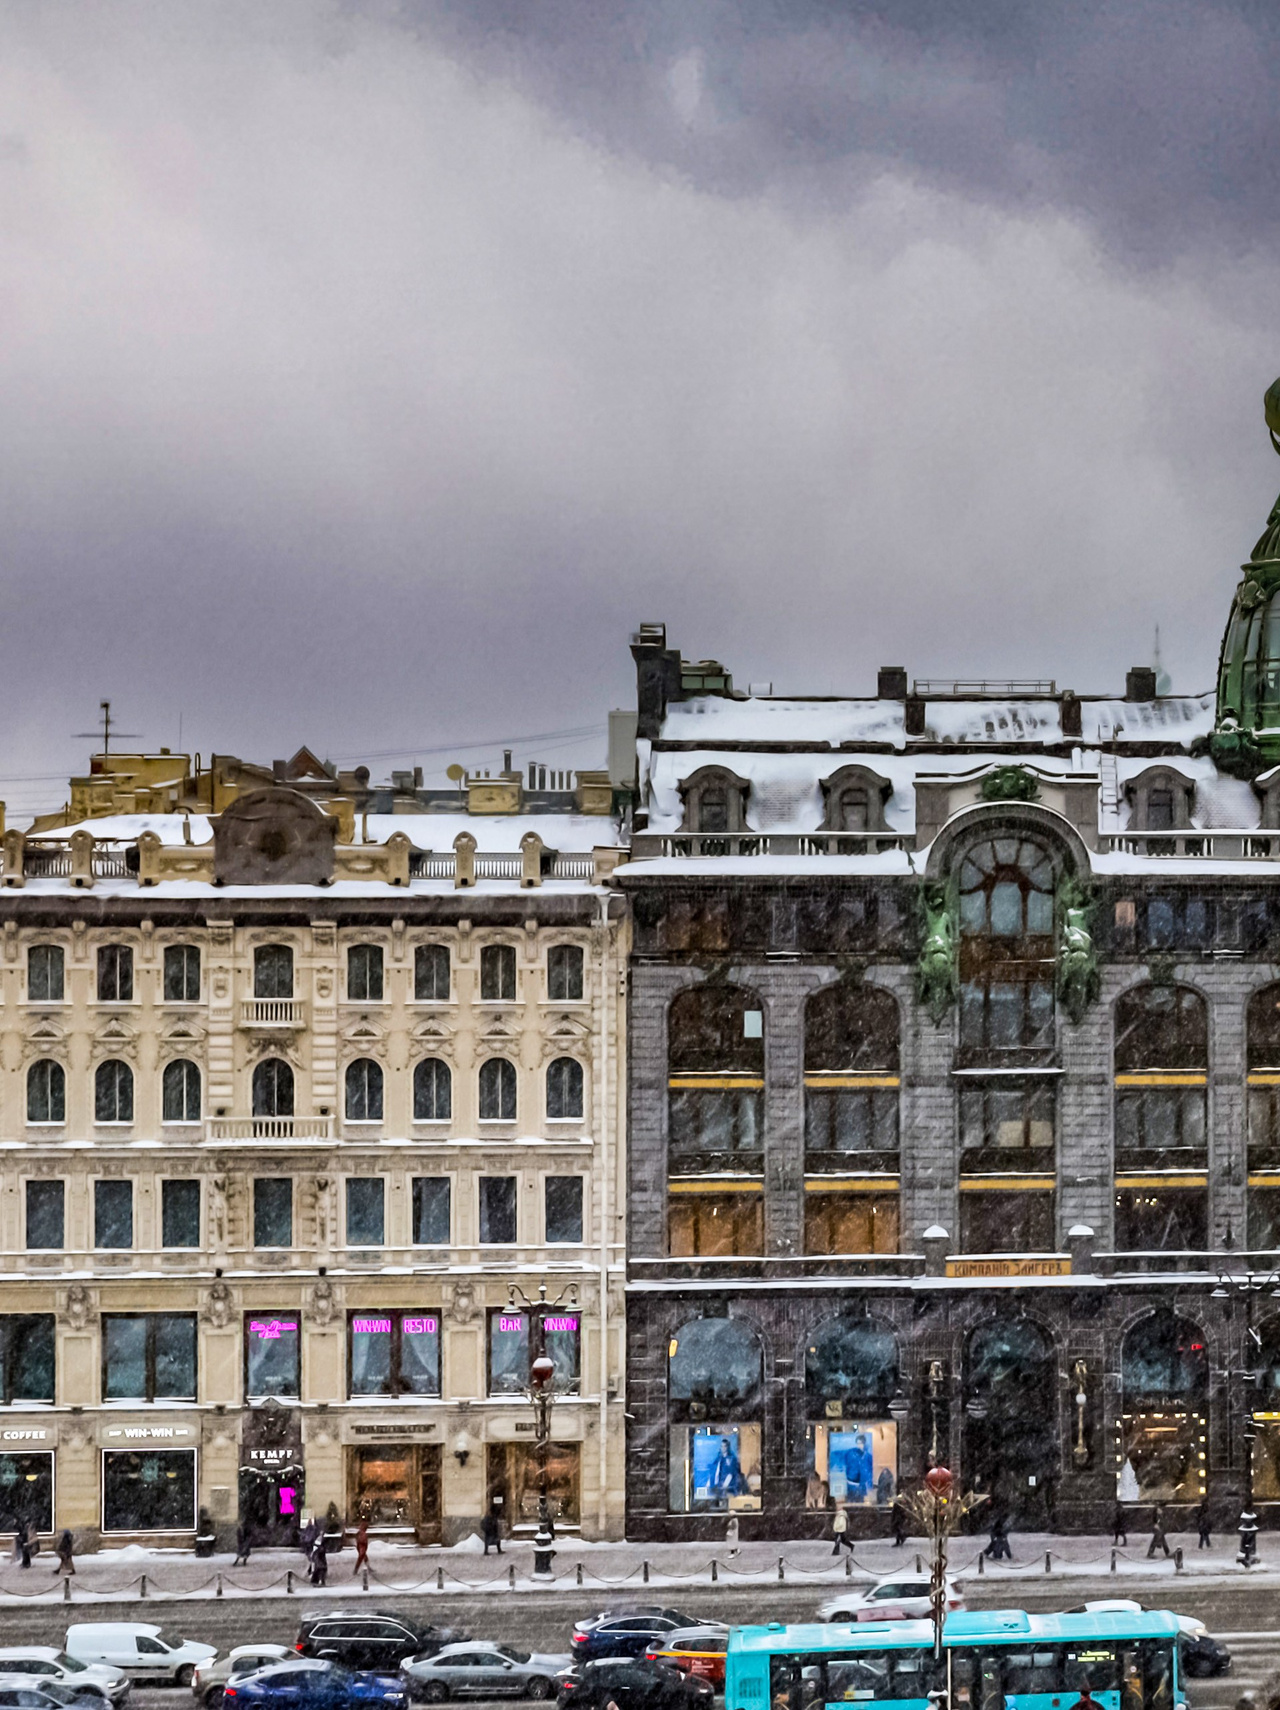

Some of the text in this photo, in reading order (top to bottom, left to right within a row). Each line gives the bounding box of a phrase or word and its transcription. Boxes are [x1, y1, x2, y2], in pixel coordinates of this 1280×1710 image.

[403, 1318, 436, 1334] RESTO
[3, 1430, 46, 1440] COFFEE
[124, 1428, 173, 1438] WIN-WIN
[251, 1449, 293, 1459] KEMPF
